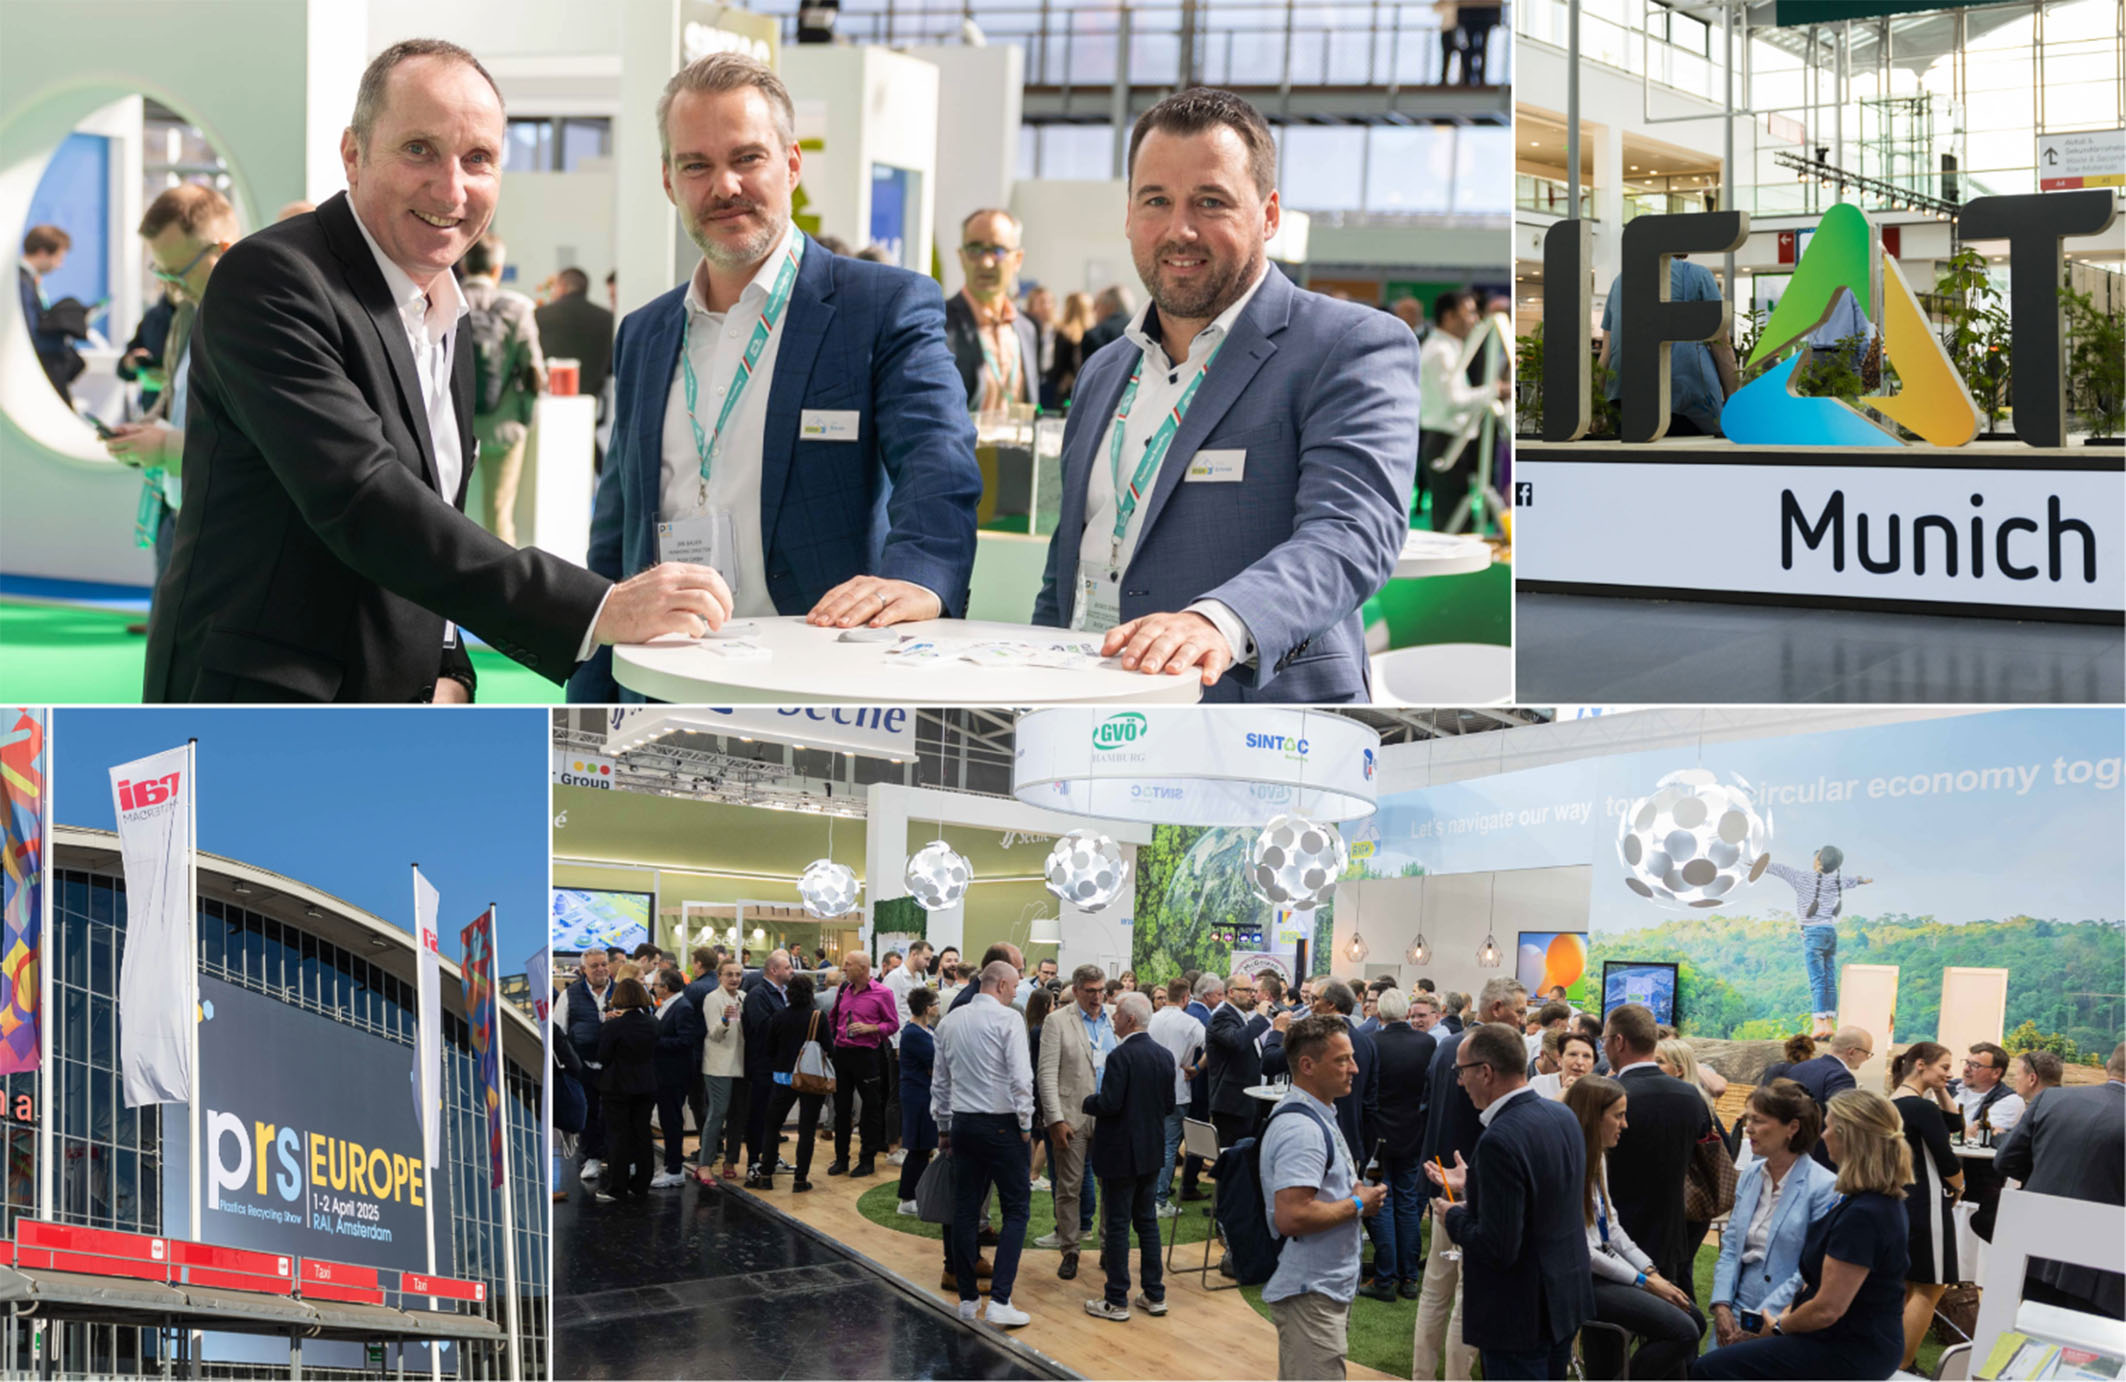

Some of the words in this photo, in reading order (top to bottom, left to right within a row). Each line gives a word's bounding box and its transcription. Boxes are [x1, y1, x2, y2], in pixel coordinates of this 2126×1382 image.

[1781, 488, 2097, 584] Munich
[1101, 718, 1137, 741] GVÖ
[1748, 775, 1860, 806] ircular
[1867, 762, 2041, 799] economy
[2052, 755, 2125, 791] tog
[1410, 817, 1445, 840] Let's
[1448, 809, 1514, 836] navigate
[1518, 806, 1550, 827] our
[1554, 800, 1593, 825] way
[207, 1109, 302, 1211] prs
[310, 1131, 424, 1208] EUROPE
[220, 1199, 247, 1216] Plastics
[247, 1203, 283, 1225] Recycling
[283, 1210, 302, 1224] Show
[313, 1192, 330, 1212] 1-2
[332, 1197, 355, 1218] April
[356, 1201, 380, 1221] 2025
[313, 1213, 334, 1236] RAI,
[336, 1217, 393, 1243] Amsterdam
[314, 1263, 332, 1280] Taxi
[413, 1277, 429, 1292] Taxi
